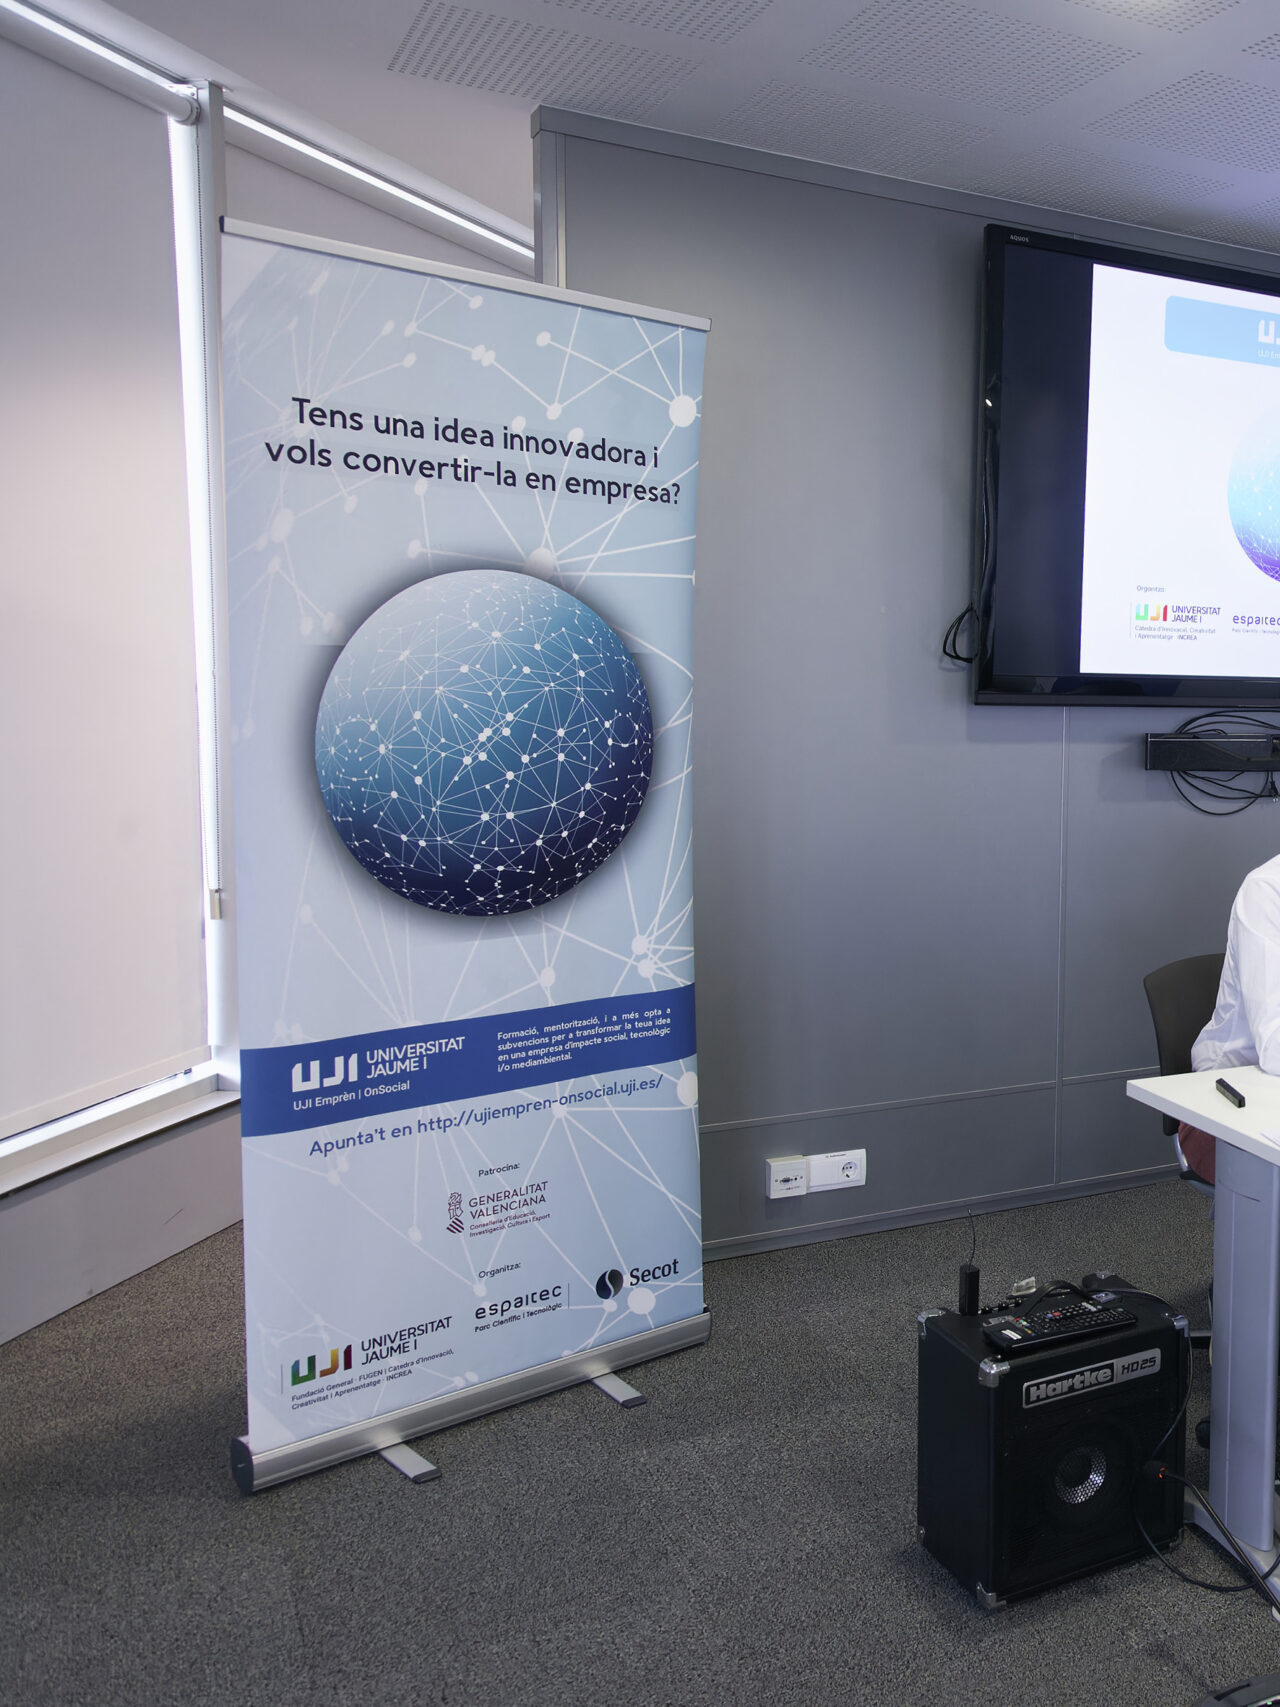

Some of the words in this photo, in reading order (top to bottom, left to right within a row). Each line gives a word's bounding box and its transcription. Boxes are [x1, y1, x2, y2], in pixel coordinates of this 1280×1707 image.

[291, 397, 364, 431] Tens
[374, 415, 425, 439] una
[434, 417, 494, 447] idea
[503, 426, 646, 467] innovadora
[653, 446, 659, 468] i
[265, 438, 332, 467] vols
[343, 451, 517, 487] convertir-la
[525, 472, 556, 492] en
[565, 477, 681, 504] empresa?
[1135, 603, 1168, 622] UJI
[1171, 604, 1221, 616] UNIVERSITAT
[1171, 614, 1198, 623] JAUME
[497, 1026, 539, 1040] Formació,
[544, 1016, 600, 1033] mentorització,
[622, 1011, 639, 1020] més
[644, 1008, 662, 1019] opta
[497, 1037, 549, 1051] subvencions
[551, 1033, 566, 1044] per
[576, 1024, 622, 1037] transformar
[624, 1022, 632, 1030] la
[634, 1020, 653, 1028] teua
[655, 1017, 671, 1026] idea
[366, 1036, 465, 1064] UNIVERSITAT
[498, 1054, 509, 1062] en
[511, 1051, 526, 1059] una
[528, 1045, 563, 1056] empresa
[564, 1037, 602, 1050] d'impacte
[603, 1032, 628, 1043] social,
[630, 1027, 671, 1039] tecnològic
[292, 1053, 358, 1092] UJI
[366, 1058, 420, 1079] JAUME
[423, 1056, 427, 1070] I
[497, 1063, 510, 1072] i/o
[512, 1051, 573, 1070] mediambiental.
[293, 1098, 312, 1111] UJI
[315, 1091, 356, 1107] Emprèn
[364, 1080, 410, 1097] OnSocial
[309, 1128, 386, 1157] Apunta't
[391, 1123, 413, 1138] en
[417, 1074, 664, 1133] http://ujiempren-onsocial.uji.es/
[478, 1162, 521, 1177] Patrocina:
[468, 1181, 549, 1208] GENERALITAT
[469, 1194, 547, 1220] VALENCIANA
[478, 1262, 522, 1278] Organitza:
[629, 1258, 679, 1286] Secot
[474, 1323, 491, 1332] Parc
[526, 1302, 562, 1317] Tecnològic
[475, 1285, 562, 1320] espaitec
[361, 1316, 453, 1352] UNIVERSITAT
[291, 1344, 352, 1386] UJI
[361, 1340, 410, 1365] JAUME
[291, 1386, 325, 1402] Fundació
[326, 1377, 354, 1391] General
[358, 1369, 383, 1382] FUGEN
[388, 1360, 414, 1373] Càtedra
[291, 1394, 329, 1410] Creativitat
[334, 1378, 381, 1398] Aprenentatge
[386, 1369, 413, 1382] INCREA
[1029, 1368, 1112, 1401] Hartke
